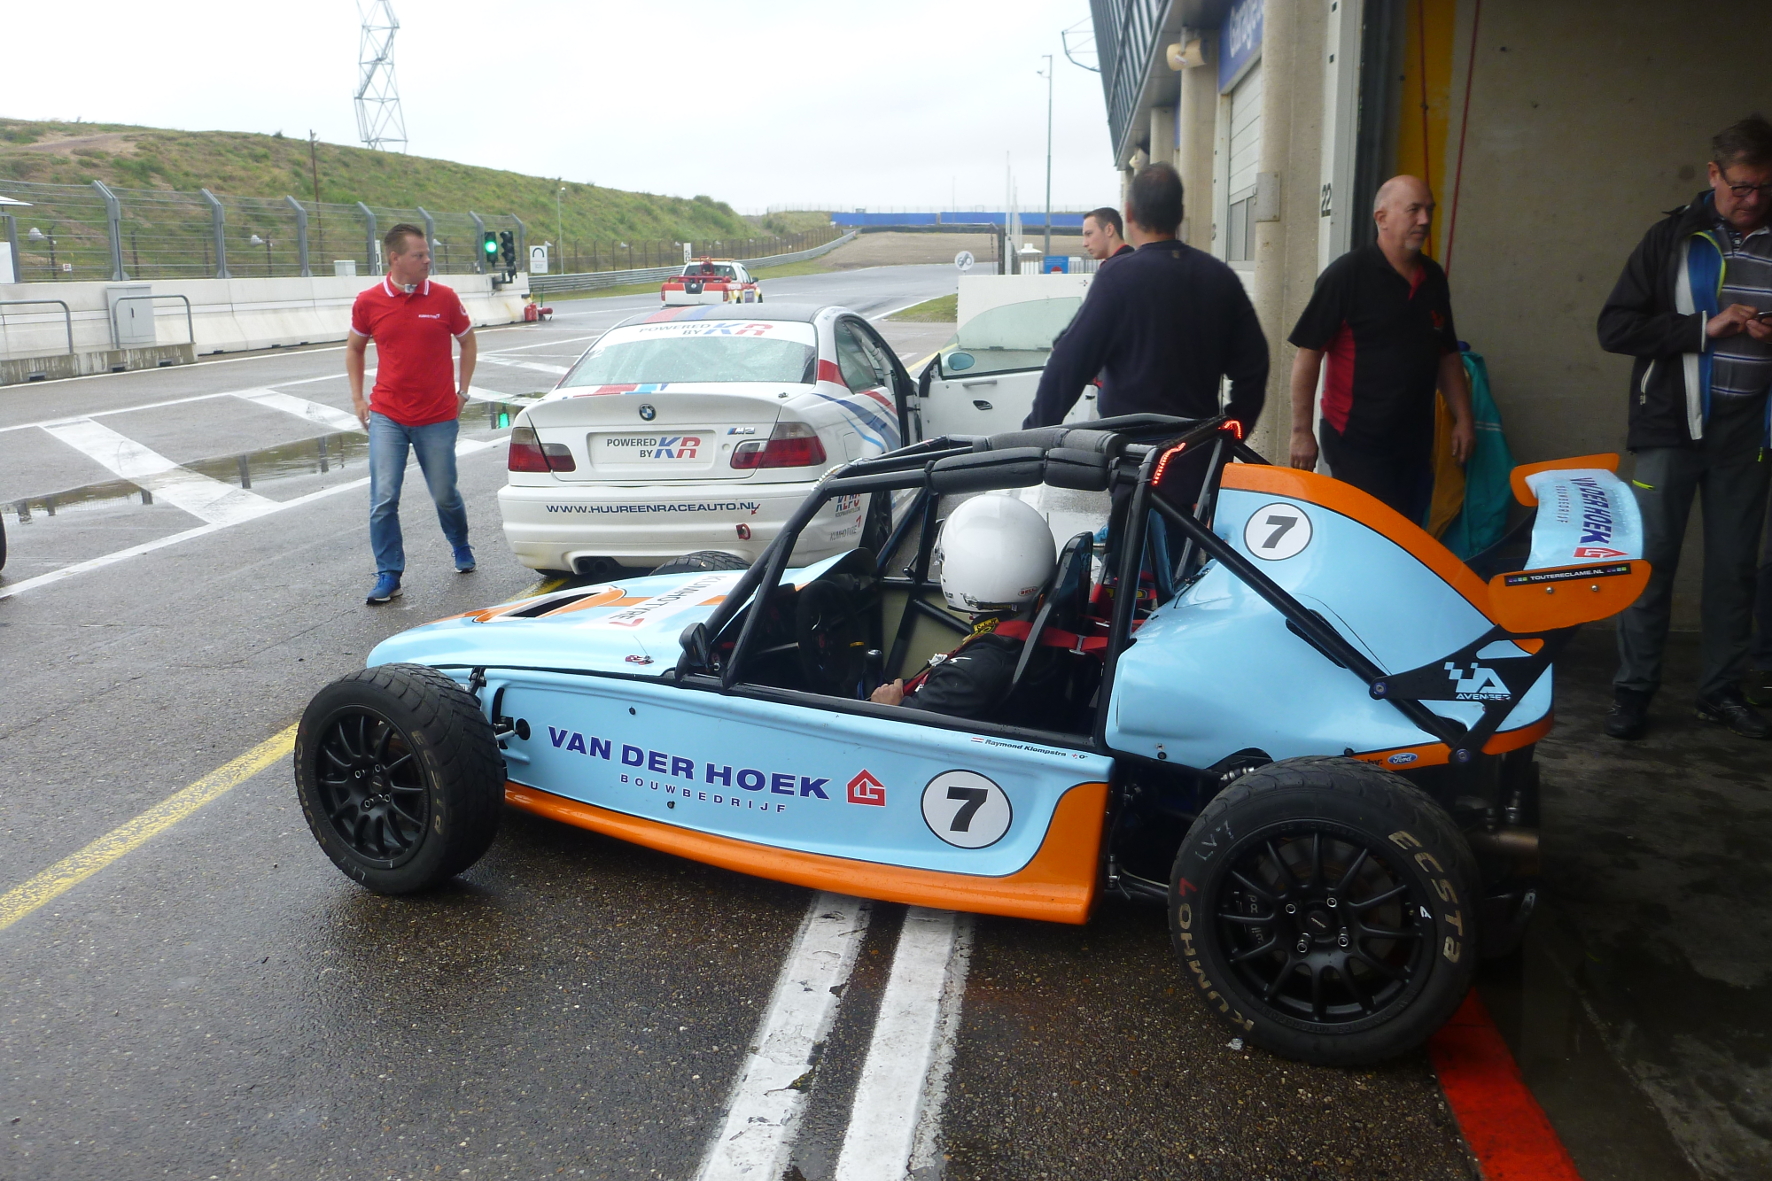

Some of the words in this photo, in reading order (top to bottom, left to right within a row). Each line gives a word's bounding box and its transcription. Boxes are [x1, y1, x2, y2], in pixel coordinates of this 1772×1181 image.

[1321, 183, 1332, 217] 22
[639, 323, 711, 333] POWERED
[606, 438, 657, 447] POWERED
[639, 450, 653, 458] BY
[654, 436, 701, 459] KR
[546, 502, 760, 514] WWW.HUUREENRACEAUTO.NL
[1580, 506, 1612, 544] HOEK
[1261, 515, 1298, 549] 7
[985, 738, 1023, 750] Raymond
[548, 726, 611, 760] VAN
[621, 744, 695, 780] DER
[705, 763, 831, 800] HOEK
[620, 774, 786, 813] BOUWBEDRIJF
[947, 786, 988, 832] 7
[1179, 903, 1255, 1031] KUMHO
